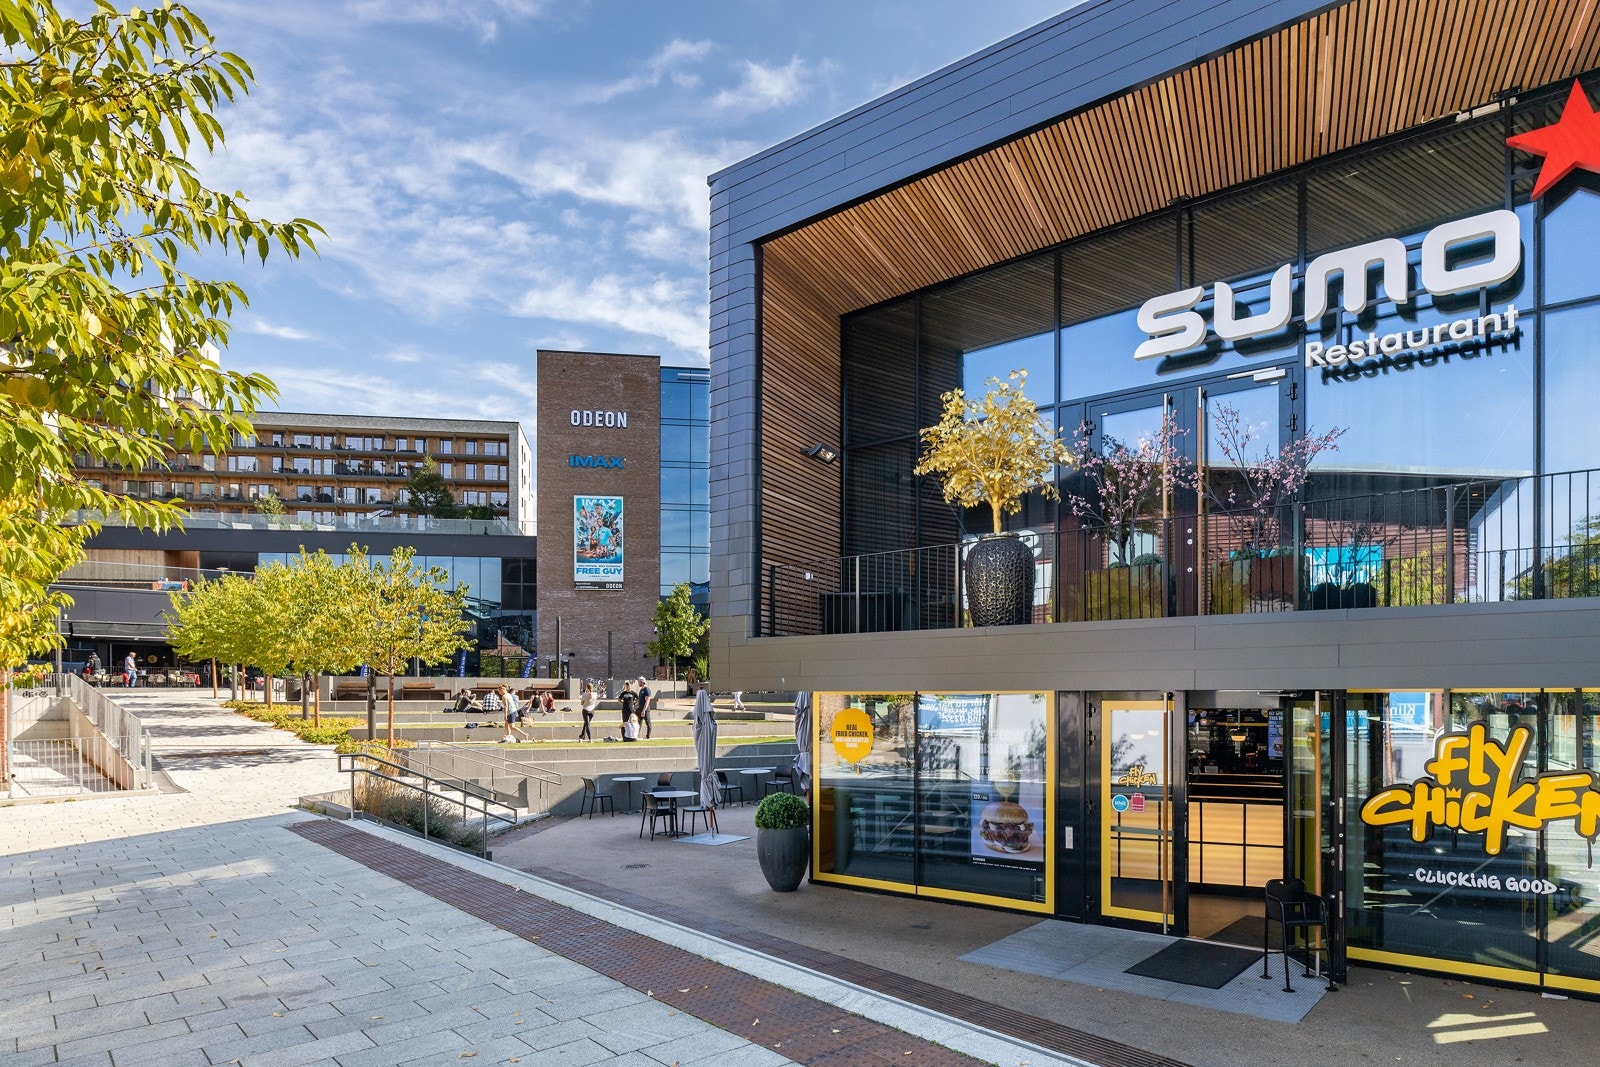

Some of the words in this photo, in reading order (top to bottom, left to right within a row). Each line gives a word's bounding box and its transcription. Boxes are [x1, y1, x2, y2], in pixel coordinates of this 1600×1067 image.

[1305, 304, 1519, 369] Restaurant
[570, 409, 627, 428] ODEON
[569, 455, 624, 469] IMAX
[581, 499, 616, 507] IMAX
